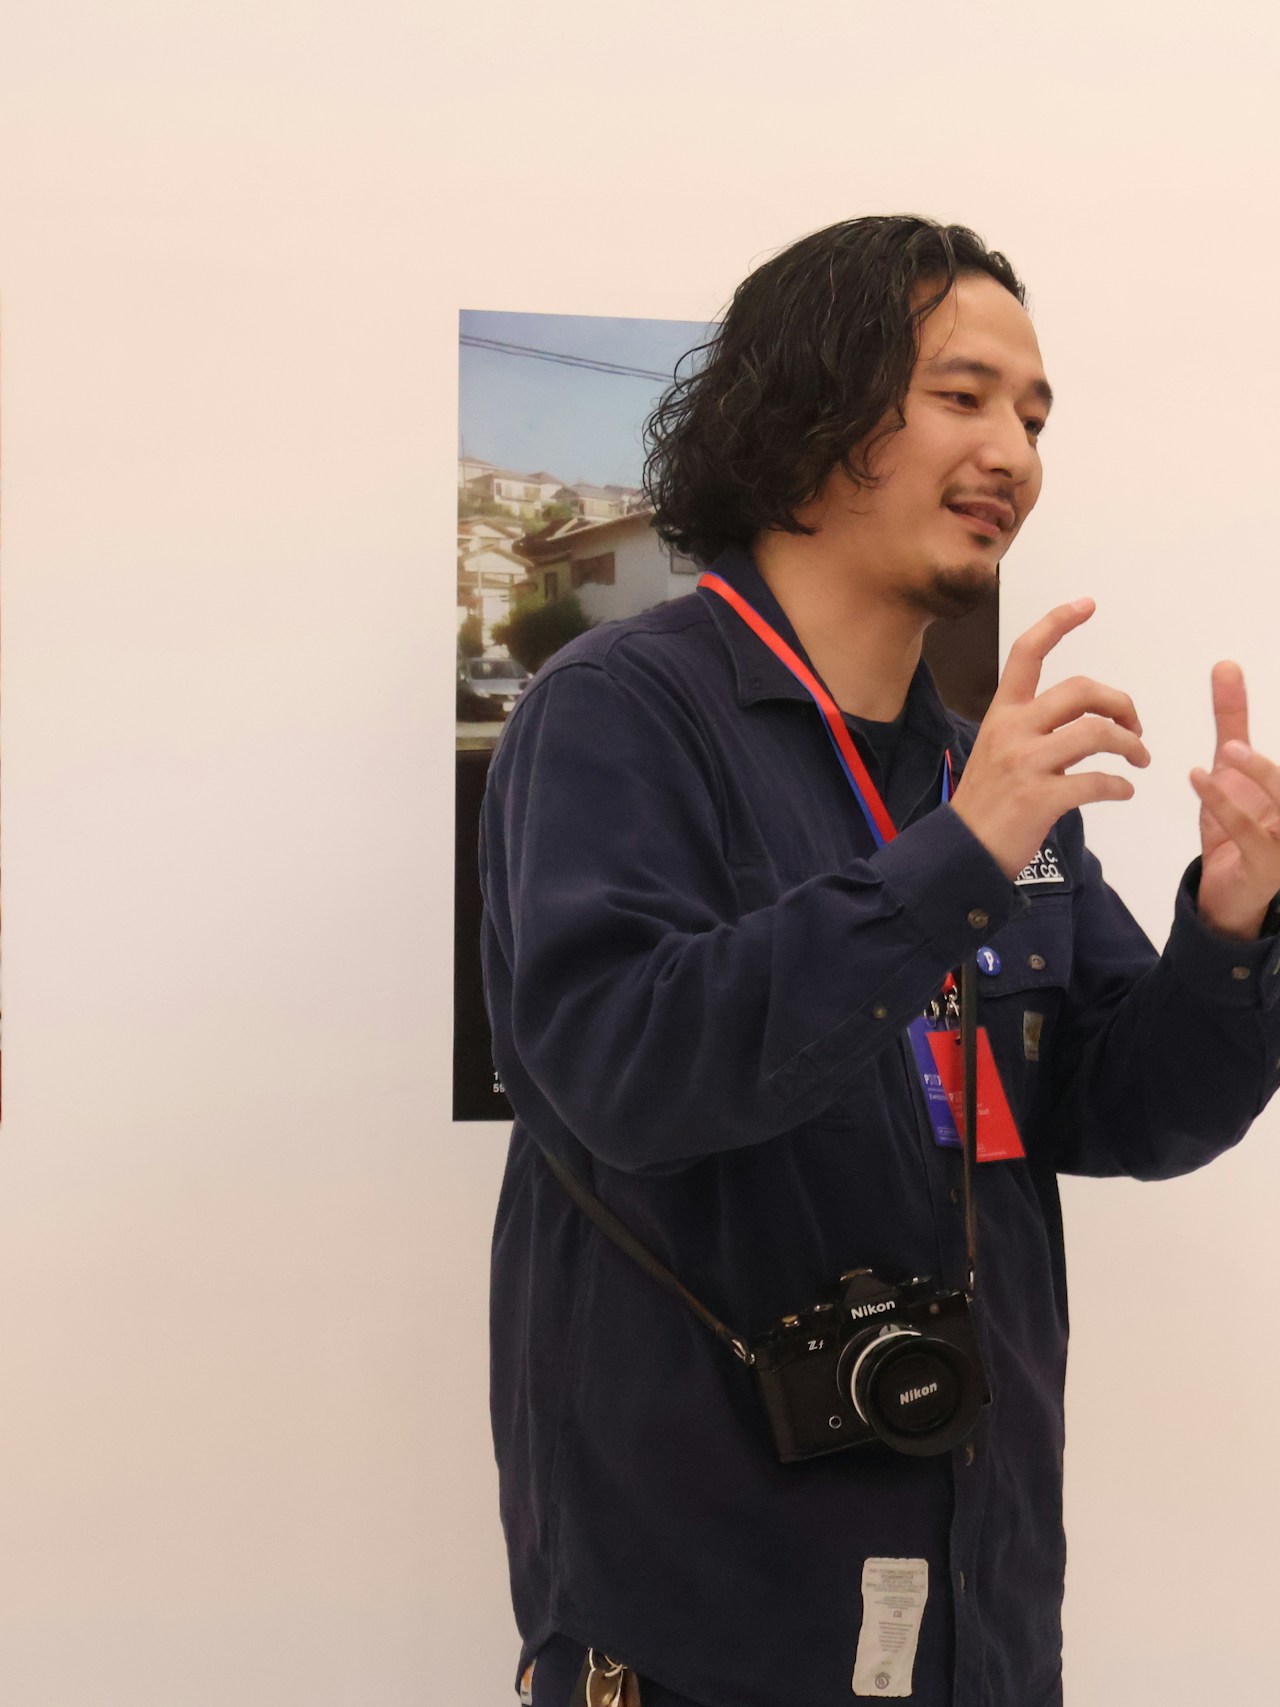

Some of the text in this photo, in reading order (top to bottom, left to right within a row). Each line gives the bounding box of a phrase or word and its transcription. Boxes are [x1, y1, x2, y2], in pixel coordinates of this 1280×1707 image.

[1044, 848, 1058, 863] C.
[1040, 864, 1061, 878] CO.
[851, 1300, 896, 1320] Nikon
[900, 1382, 938, 1405] Nikon
